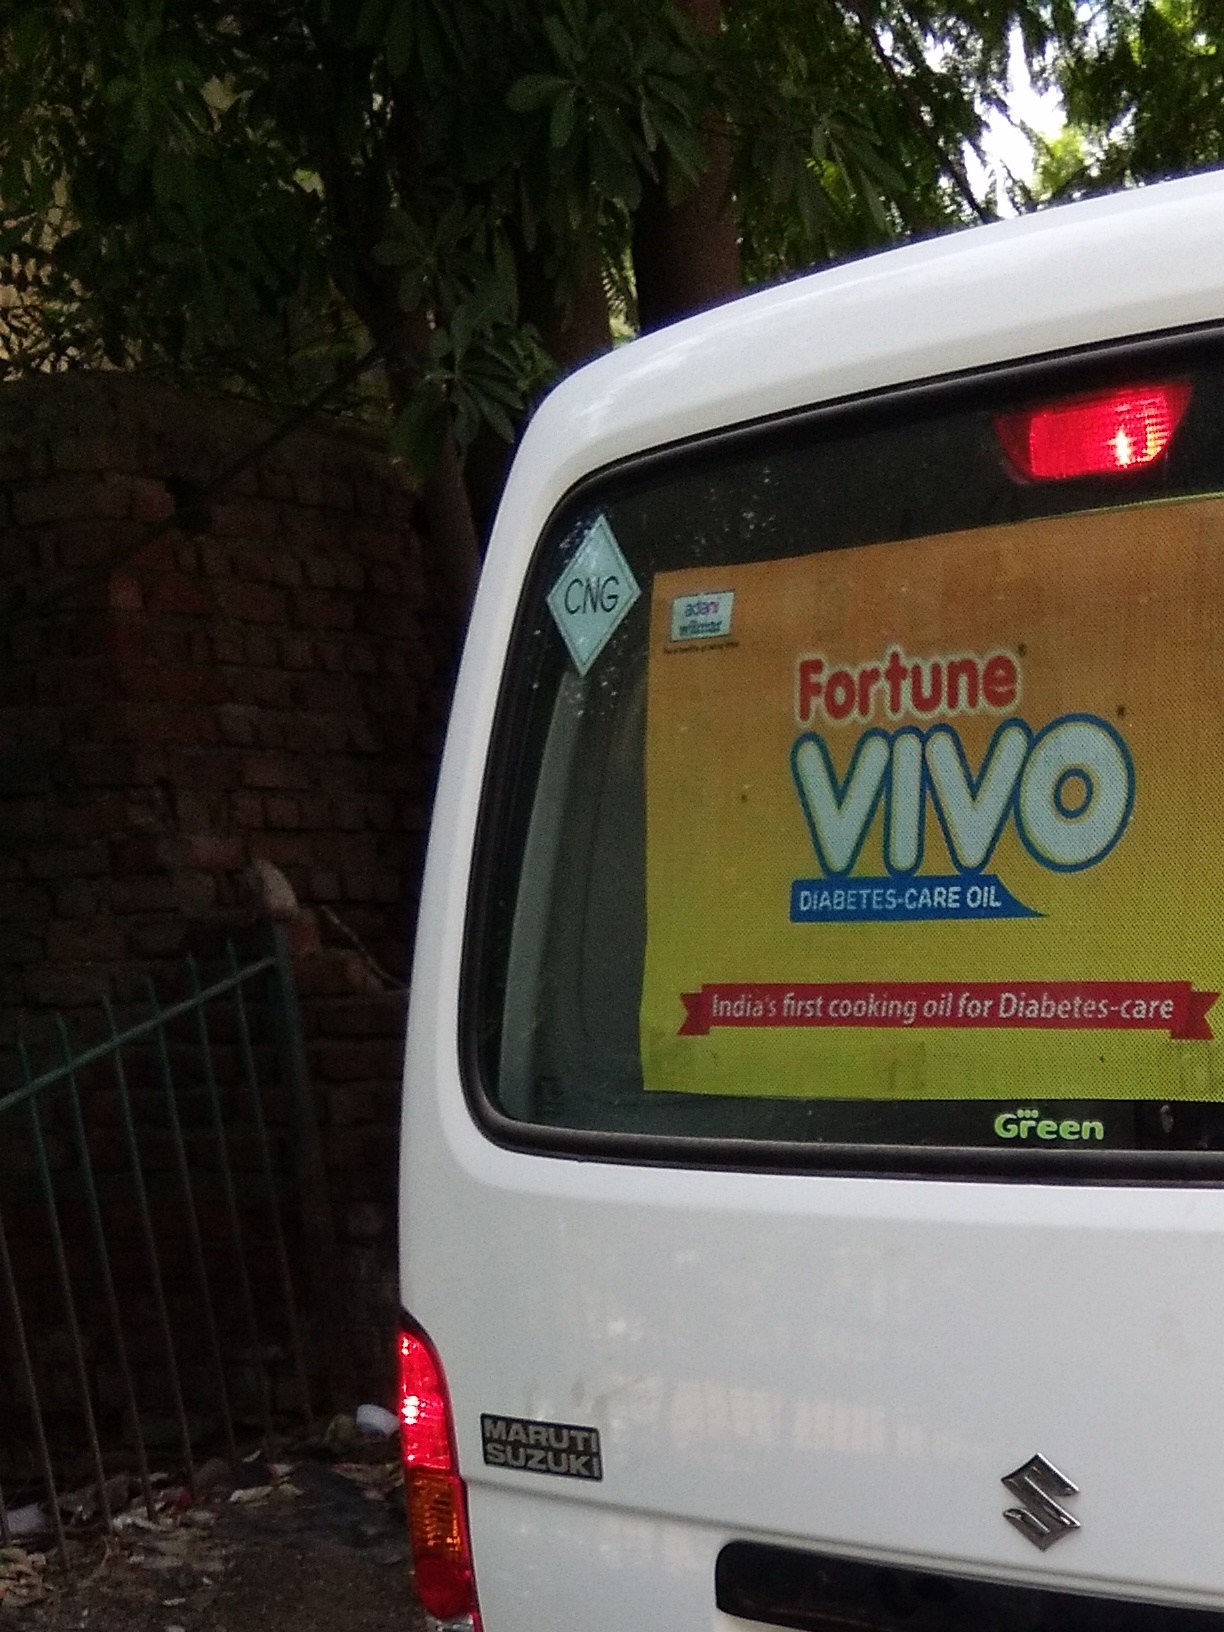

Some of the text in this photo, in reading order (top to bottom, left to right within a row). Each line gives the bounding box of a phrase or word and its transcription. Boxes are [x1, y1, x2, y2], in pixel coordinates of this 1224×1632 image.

[564, 577, 619, 616] CNG
[798, 650, 1020, 721] Fortune
[790, 713, 1136, 876] VIVO
[800, 884, 1003, 911] DIABETES-CARE OIL
[711, 992, 1175, 1025] India's first cooking oil for Diabetes-care
[994, 1109, 1105, 1140] Green
[483, 1419, 599, 1453] MARUTI
[485, 1441, 602, 1478] SUZUKI
